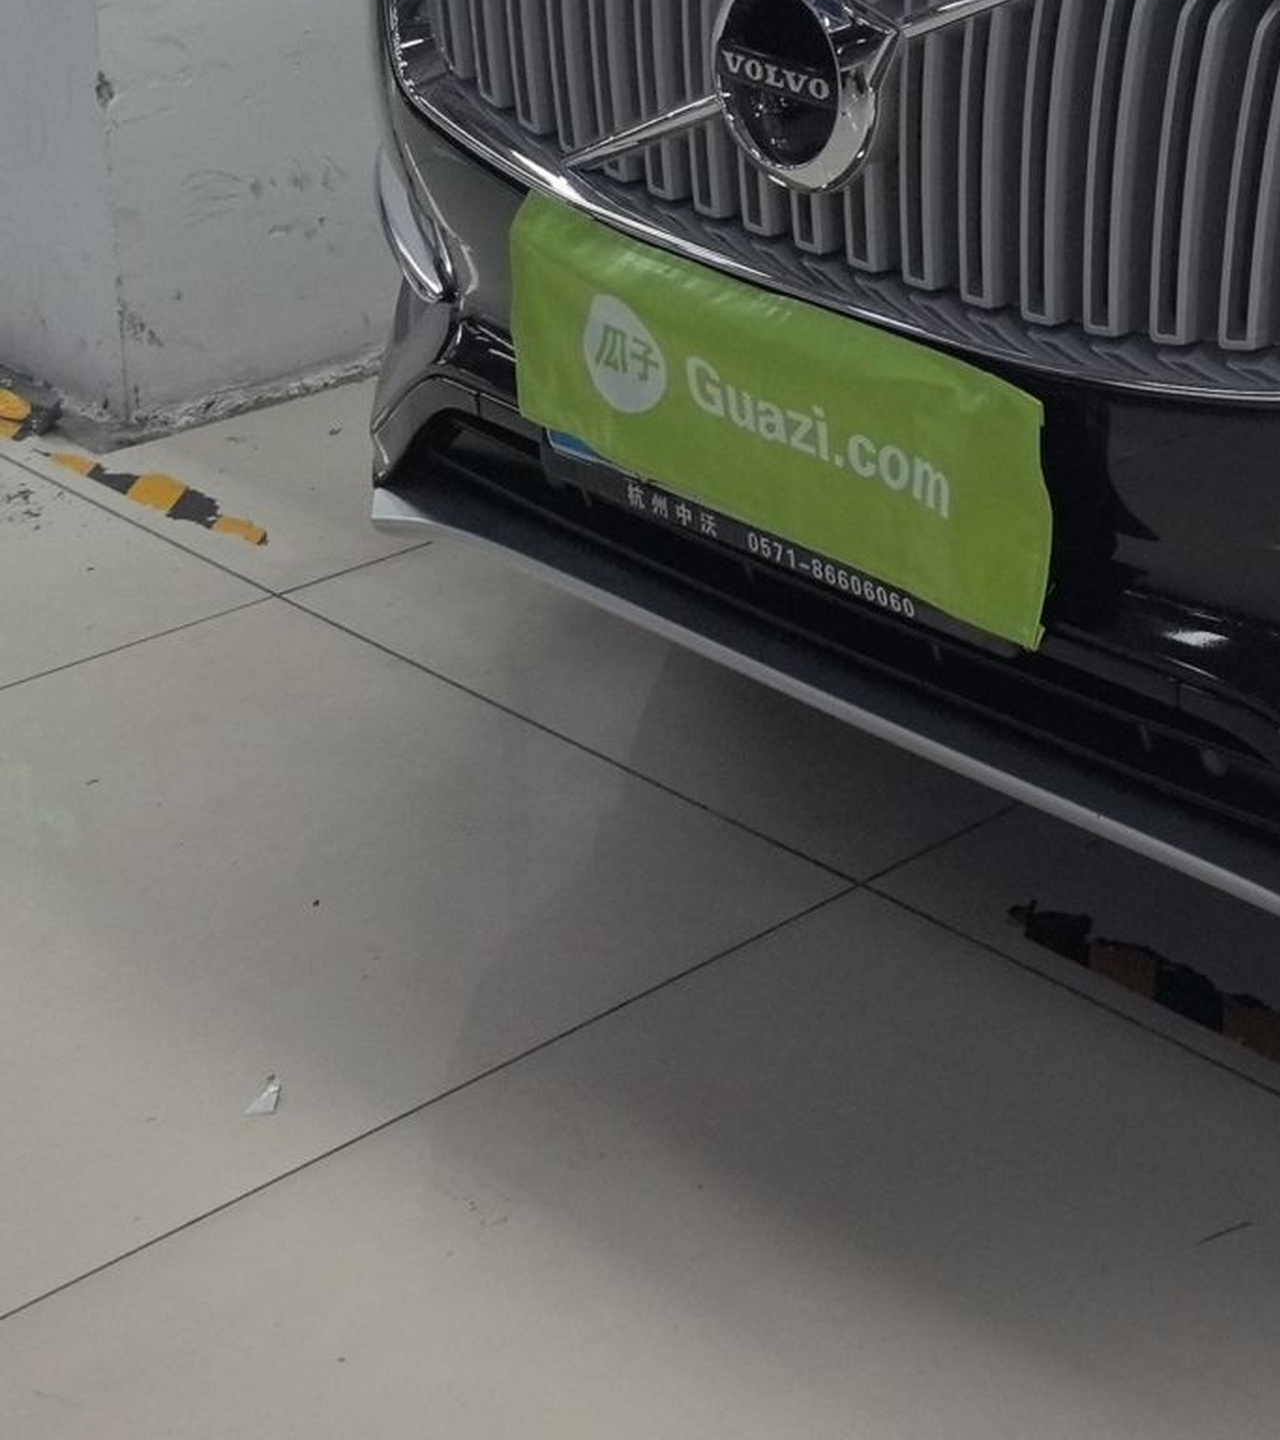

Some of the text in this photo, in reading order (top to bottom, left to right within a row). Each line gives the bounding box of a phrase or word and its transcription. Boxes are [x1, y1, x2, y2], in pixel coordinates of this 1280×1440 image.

[721, 50, 830, 100] VOLVO
[594, 323, 660, 382] 瓜子
[687, 356, 950, 521] Guazi.com
[747, 531, 915, 619] 0571-86606060
